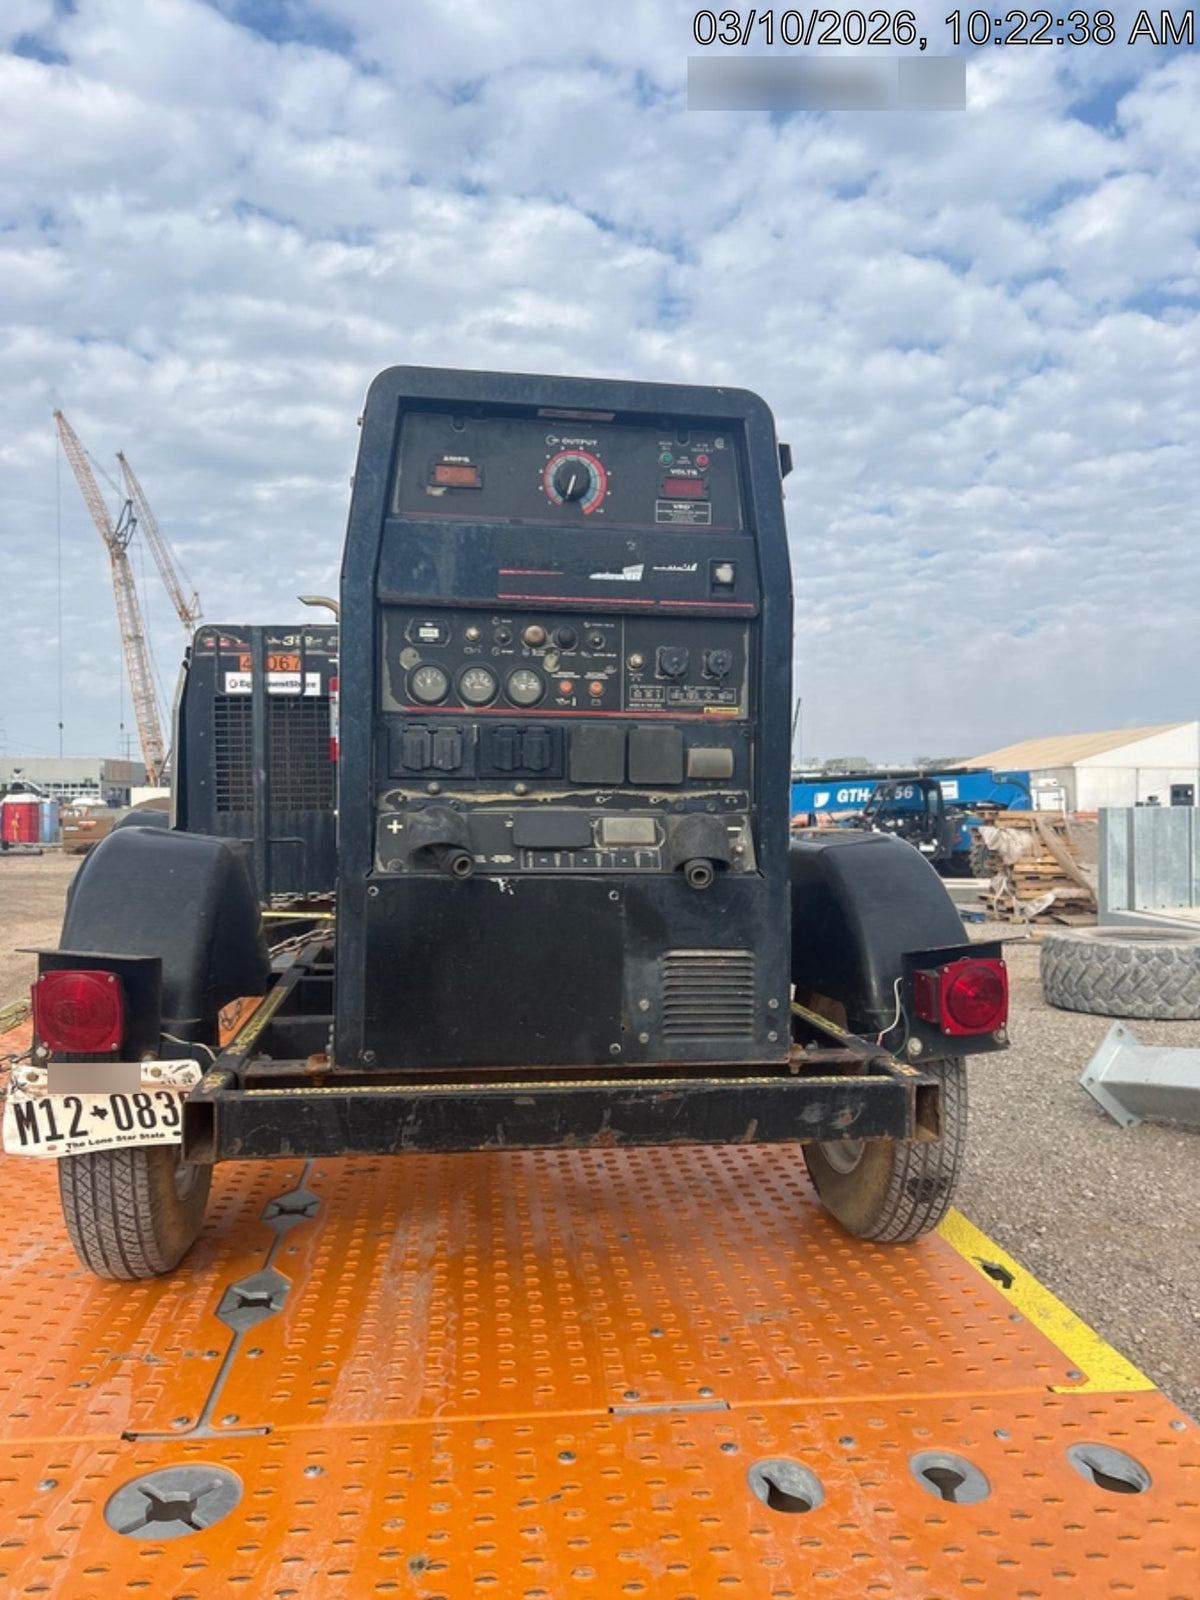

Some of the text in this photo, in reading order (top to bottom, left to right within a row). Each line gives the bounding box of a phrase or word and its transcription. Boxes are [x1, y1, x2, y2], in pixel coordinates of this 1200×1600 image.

[109, 1091, 190, 1131] 083
[88, 1137, 113, 1146] Lone
[116, 1134, 137, 1142] Star
